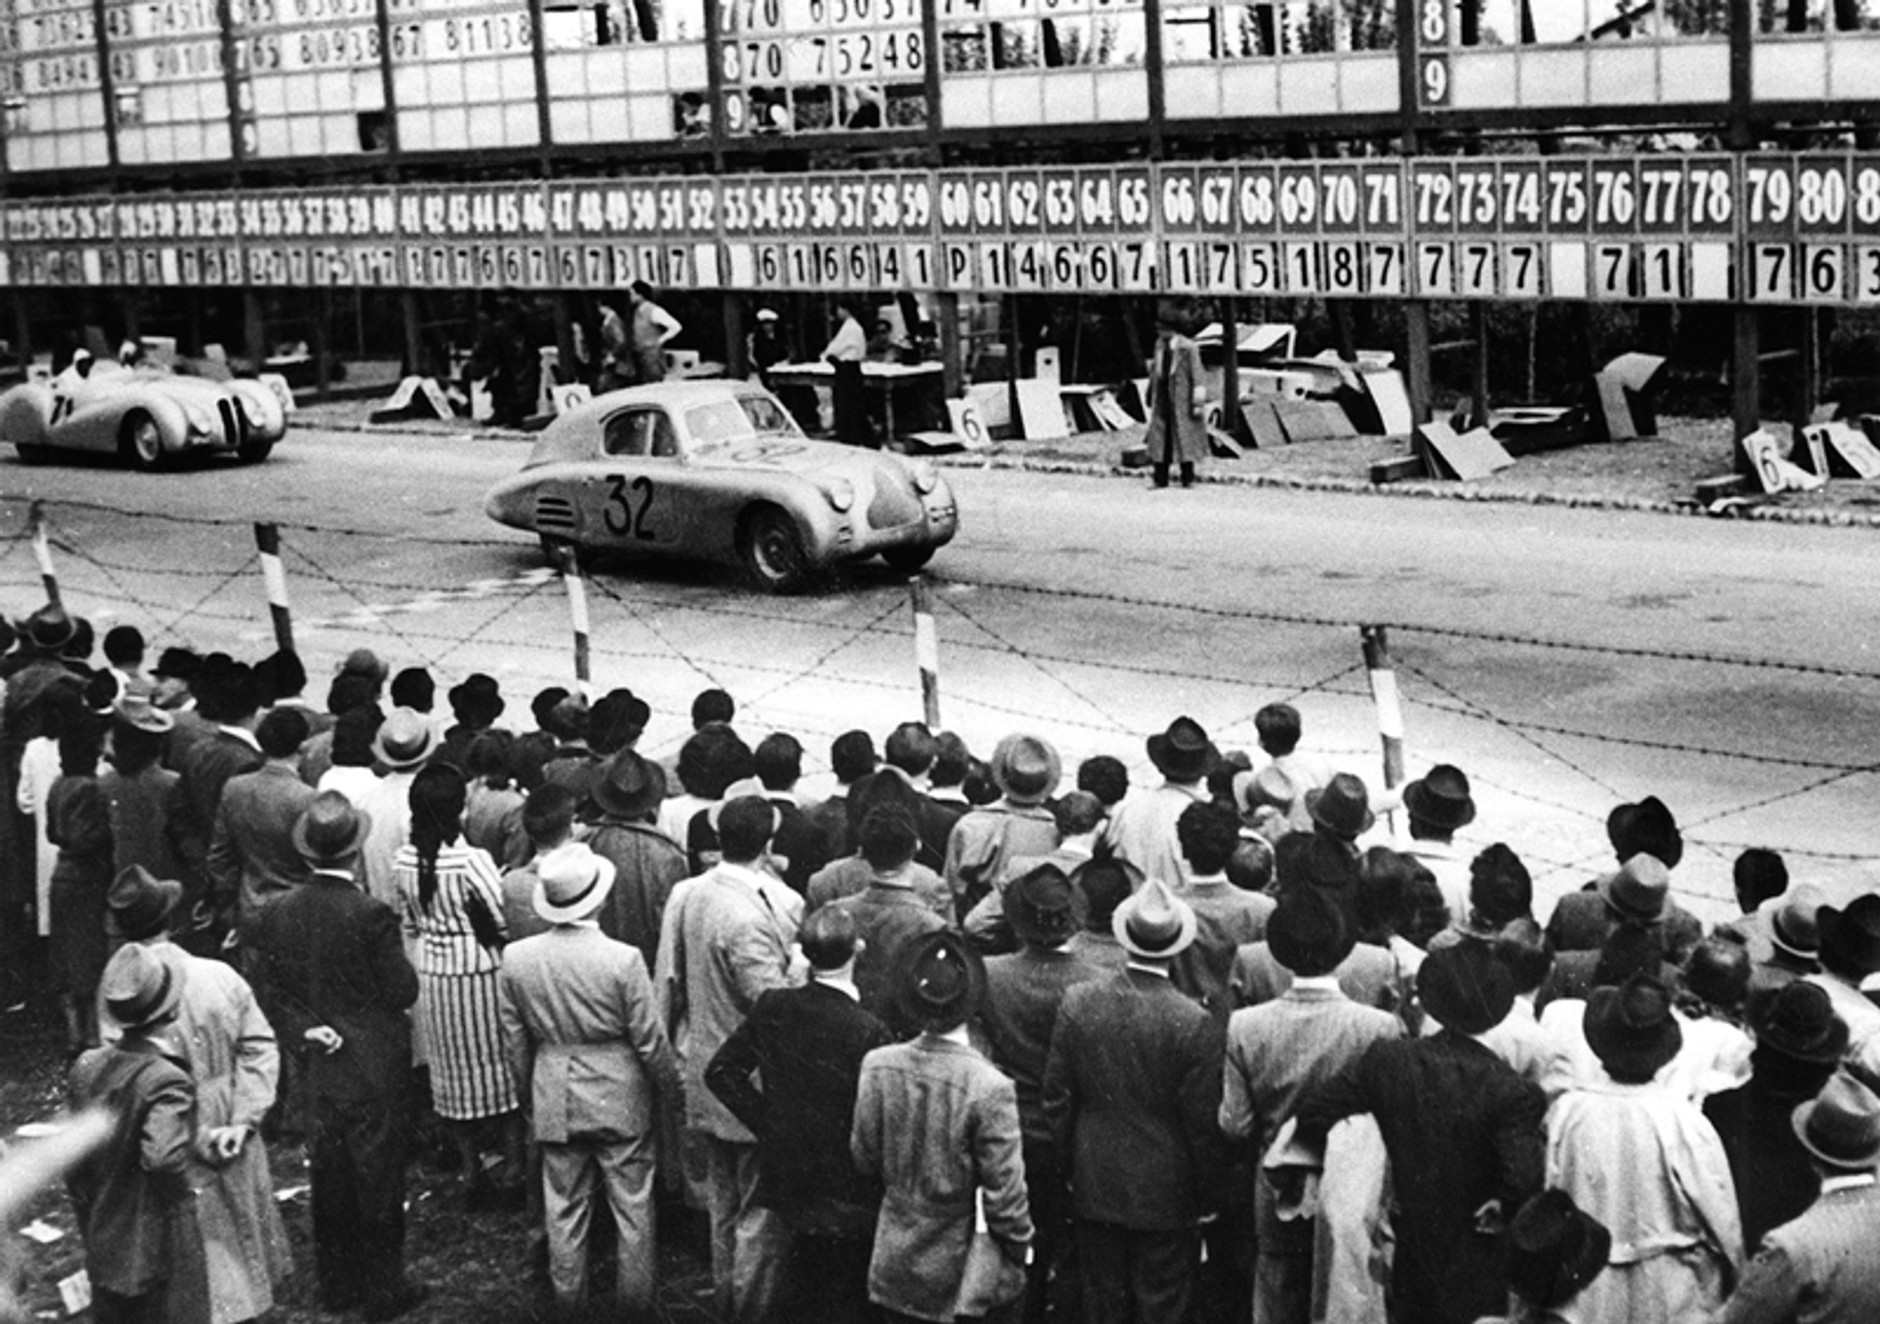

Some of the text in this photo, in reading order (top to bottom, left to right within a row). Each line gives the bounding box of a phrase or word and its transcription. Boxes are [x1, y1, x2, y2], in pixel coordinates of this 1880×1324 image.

[393, 13, 532, 57] 67 81138
[1422, 0, 1443, 41] 8
[723, 32, 922, 80] 8 70 75248
[1424, 59, 1446, 101] 9
[726, 94, 742, 129] 9
[632, 191, 656, 229] 50
[661, 190, 683, 228] 51
[689, 189, 715, 228] 52
[724, 188, 749, 228] 53
[752, 187, 779, 228] 54
[780, 186, 806, 228] 55
[811, 186, 837, 227] 56
[841, 185, 865, 226] 57
[872, 184, 899, 226] 58
[903, 183, 930, 226] 59
[940, 182, 970, 225] 60
[974, 182, 1002, 226] 61
[1009, 181, 1039, 225] 62
[1046, 180, 1075, 224] 63
[1081, 179, 1113, 224] 64
[1120, 179, 1149, 224] 65
[1164, 178, 1194, 223] 66
[1202, 178, 1232, 223] 67
[1241, 177, 1273, 223] 68
[1280, 177, 1315, 223] 69
[1323, 175, 1356, 223] 70
[1366, 175, 1397, 222] 71
[1417, 174, 1452, 222] 72
[1459, 173, 1495, 223] 73
[1504, 173, 1540, 222] 74
[1549, 172, 1585, 222] 75
[1596, 172, 1634, 223] 76
[1643, 171, 1681, 222] 77
[1691, 170, 1731, 222] 78
[1748, 169, 1790, 221] 79
[1798, 170, 1845, 223] 80
[433, 250, 445, 281] 7
[456, 250, 468, 280] 7
[481, 250, 494, 280] 6
[507, 251, 518, 280] 6
[531, 249, 545, 280] 7
[562, 251, 575, 282] 6
[589, 250, 600, 281] 7
[617, 248, 631, 280] 3
[645, 250, 655, 281] 1
[672, 249, 684, 281] 7
[762, 248, 776, 281] 6
[794, 249, 804, 282] 1
[824, 247, 838, 280] 6
[850, 246, 865, 279] 6
[884, 247, 898, 281] 4
[917, 249, 927, 283] 1
[951, 247, 965, 281] P
[989, 249, 999, 283] 1
[1020, 247, 1036, 282] 4
[1055, 246, 1071, 283] 6
[1091, 246, 1107, 283] 6
[1126, 246, 1142, 281] 7
[1179, 248, 1190, 285] 1
[1213, 246, 1229, 283] 7
[1252, 249, 1268, 287] 5
[1296, 248, 1308, 287] 1
[1335, 247, 1352, 287] 8
[1375, 246, 1393, 286] 7
[1425, 246, 1443, 286] 7
[1469, 247, 1487, 288] 7
[1511, 247, 1532, 289] 7
[1602, 248, 1622, 291] 7
[1655, 248, 1671, 292] 1
[1763, 247, 1785, 292] 7
[1812, 248, 1835, 293] 6
[962, 408, 981, 441] 6
[1761, 445, 1781, 486] 6
[604, 474, 655, 540] 32
